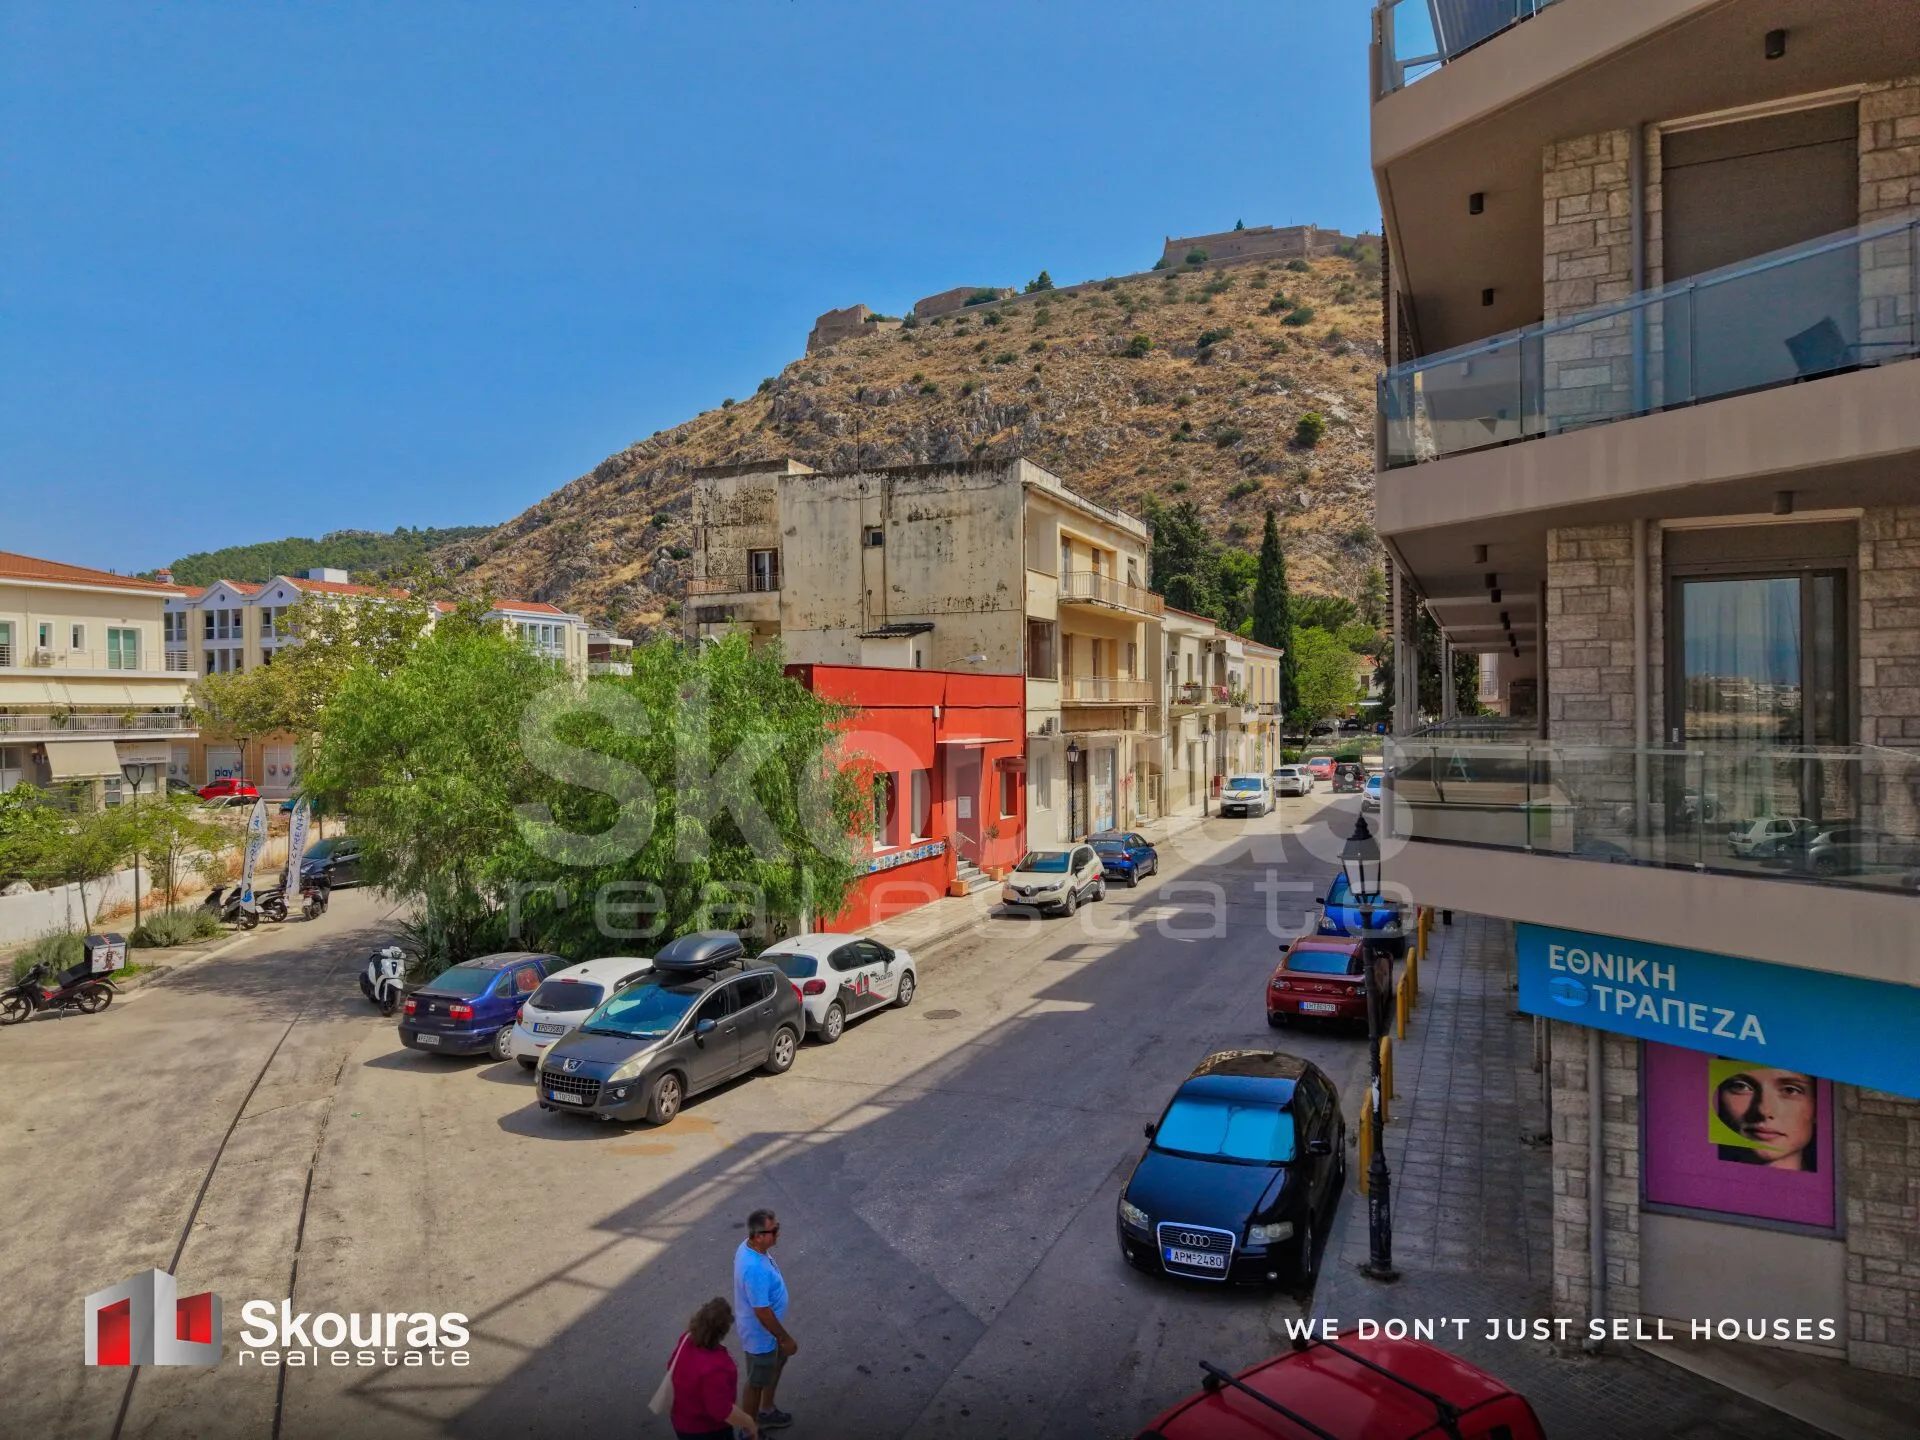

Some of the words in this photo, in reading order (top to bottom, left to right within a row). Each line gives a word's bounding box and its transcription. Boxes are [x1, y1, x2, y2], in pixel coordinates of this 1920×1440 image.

[214, 767, 233, 779] play
[1549, 945, 1676, 992] ΕΘΝΙΚΗ
[1592, 984, 1767, 1045] ΤΡΑΠΕΖΑ
